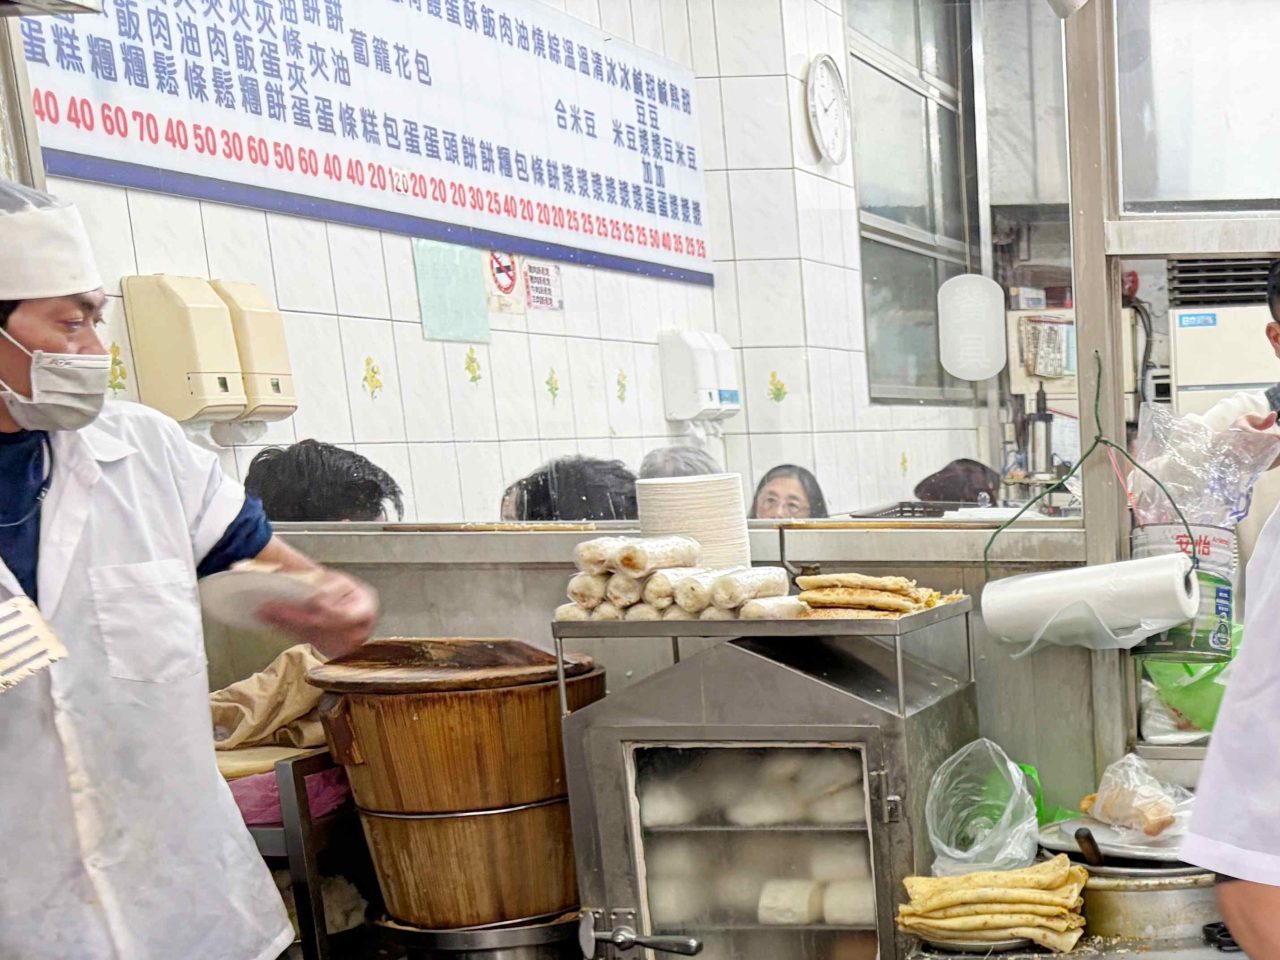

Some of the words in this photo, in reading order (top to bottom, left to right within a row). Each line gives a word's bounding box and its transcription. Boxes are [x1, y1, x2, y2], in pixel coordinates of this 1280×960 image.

[32, 87, 60, 125] 40
[66, 95, 95, 132] 40
[100, 102, 129, 139] 60
[131, 110, 160, 145] 70
[164, 118, 189, 150] 40
[192, 123, 218, 157] 50
[220, 129, 244, 162] 30
[246, 135, 270, 168] 60
[273, 141, 295, 173] 50
[297, 146, 319, 178] 60
[322, 152, 343, 183] 40
[345, 158, 366, 187] 40
[367, 162, 387, 192] 20
[410, 172, 428, 200] 20
[430, 176, 448, 204] 20
[449, 181, 467, 208] 20
[467, 186, 485, 212] 30
[485, 190, 502, 216] 25
[502, 194, 518, 219] 40
[519, 198, 535, 222] 20
[536, 203, 551, 226] 20
[551, 206, 566, 230] 20
[566, 208, 580, 233] 25
[581, 212, 595, 236] 25
[596, 216, 609, 240] 25
[610, 219, 623, 243] 25
[623, 222, 635, 245] 25
[636, 225, 648, 247] 25
[685, 237, 696, 257] 25
[696, 239, 707, 259] 25
[1175, 534, 1211, 557] 安怡
